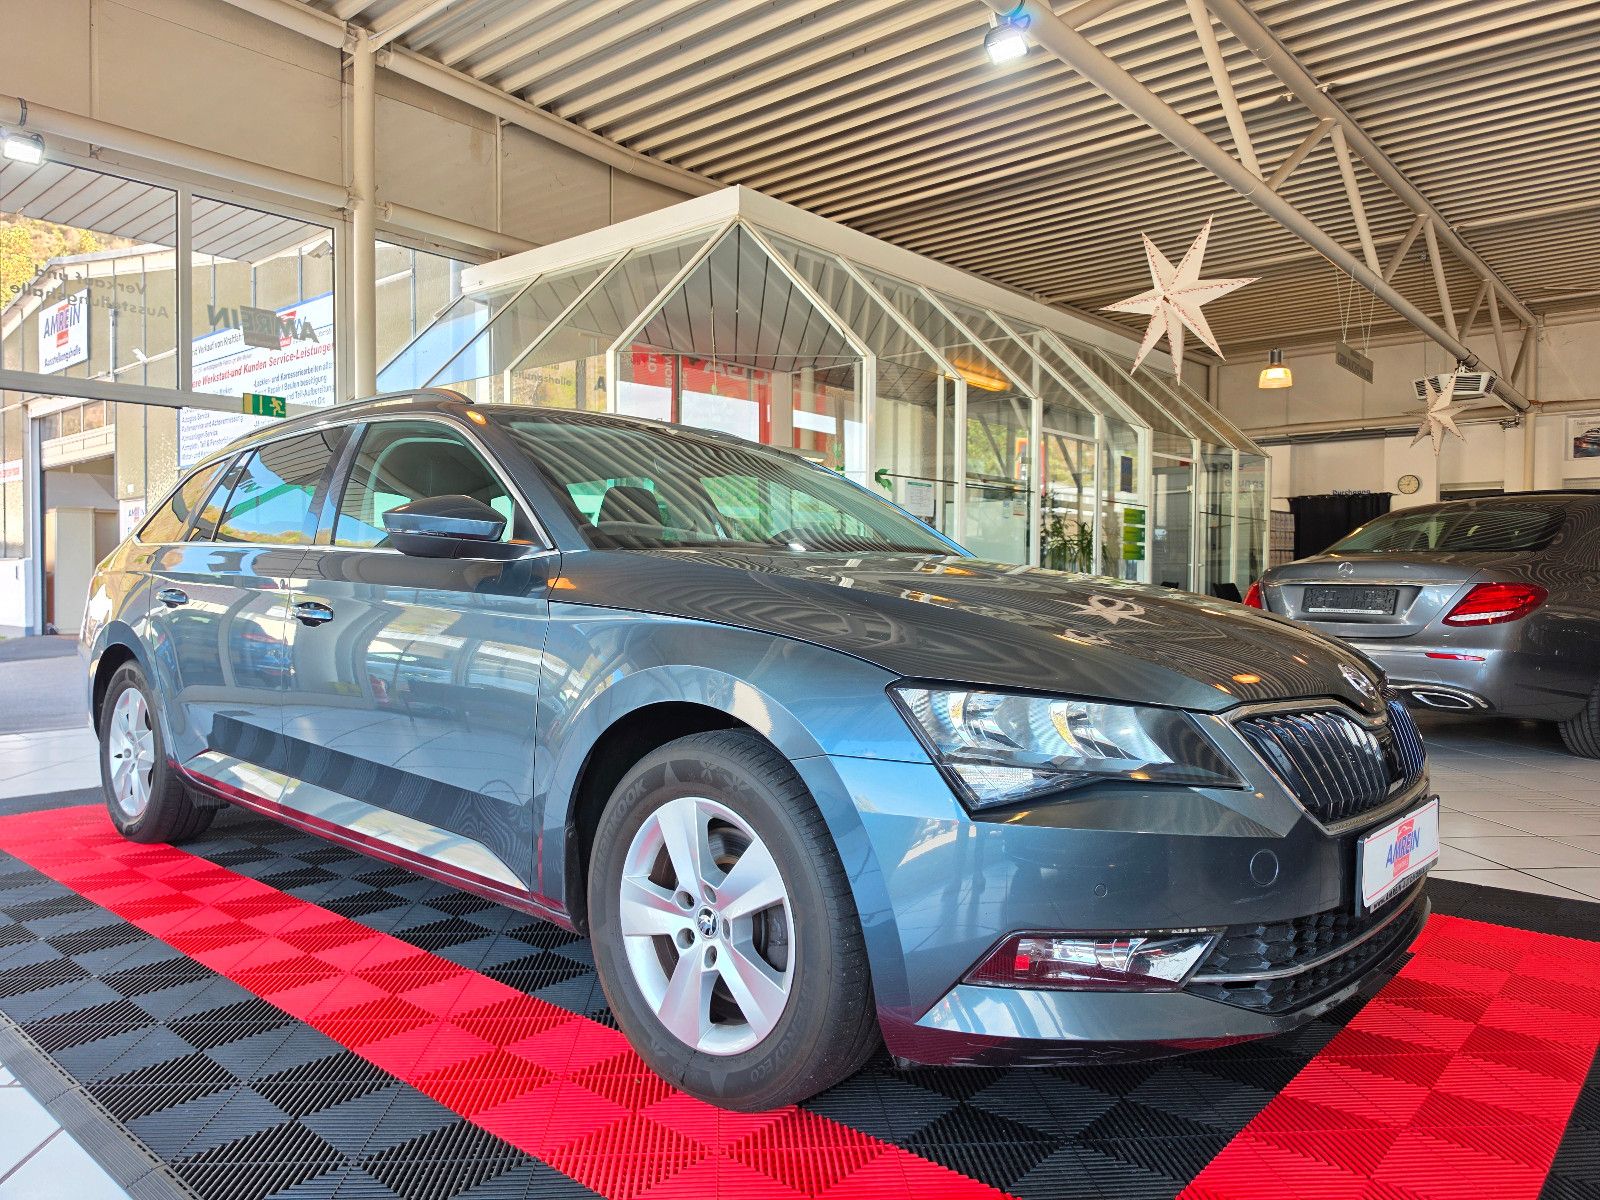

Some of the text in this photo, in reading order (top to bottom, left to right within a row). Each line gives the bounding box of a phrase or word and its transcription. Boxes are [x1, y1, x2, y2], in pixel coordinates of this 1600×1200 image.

[43, 303, 81, 339] AMREIN
[243, 360, 267, 375] Kunden
[1385, 826, 1421, 868] AMREIN
